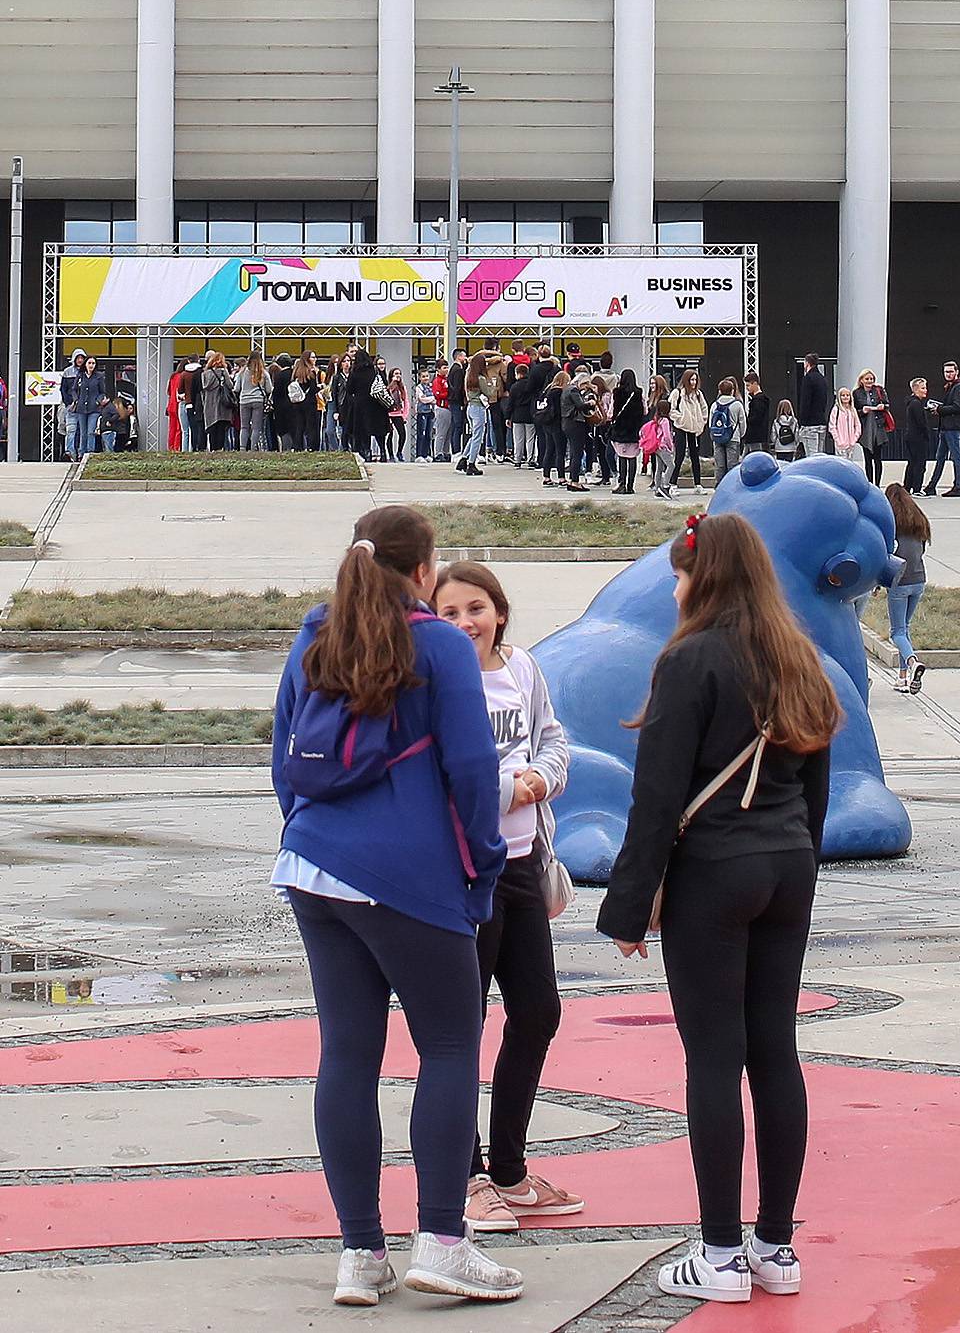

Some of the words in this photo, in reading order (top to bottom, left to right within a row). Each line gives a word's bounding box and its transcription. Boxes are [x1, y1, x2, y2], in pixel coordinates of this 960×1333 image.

[257, 281, 362, 301] TOTALNI
[647, 278, 733, 291] BUSINESS
[607, 294, 628, 317] A1
[675, 296, 705, 310] VIP
